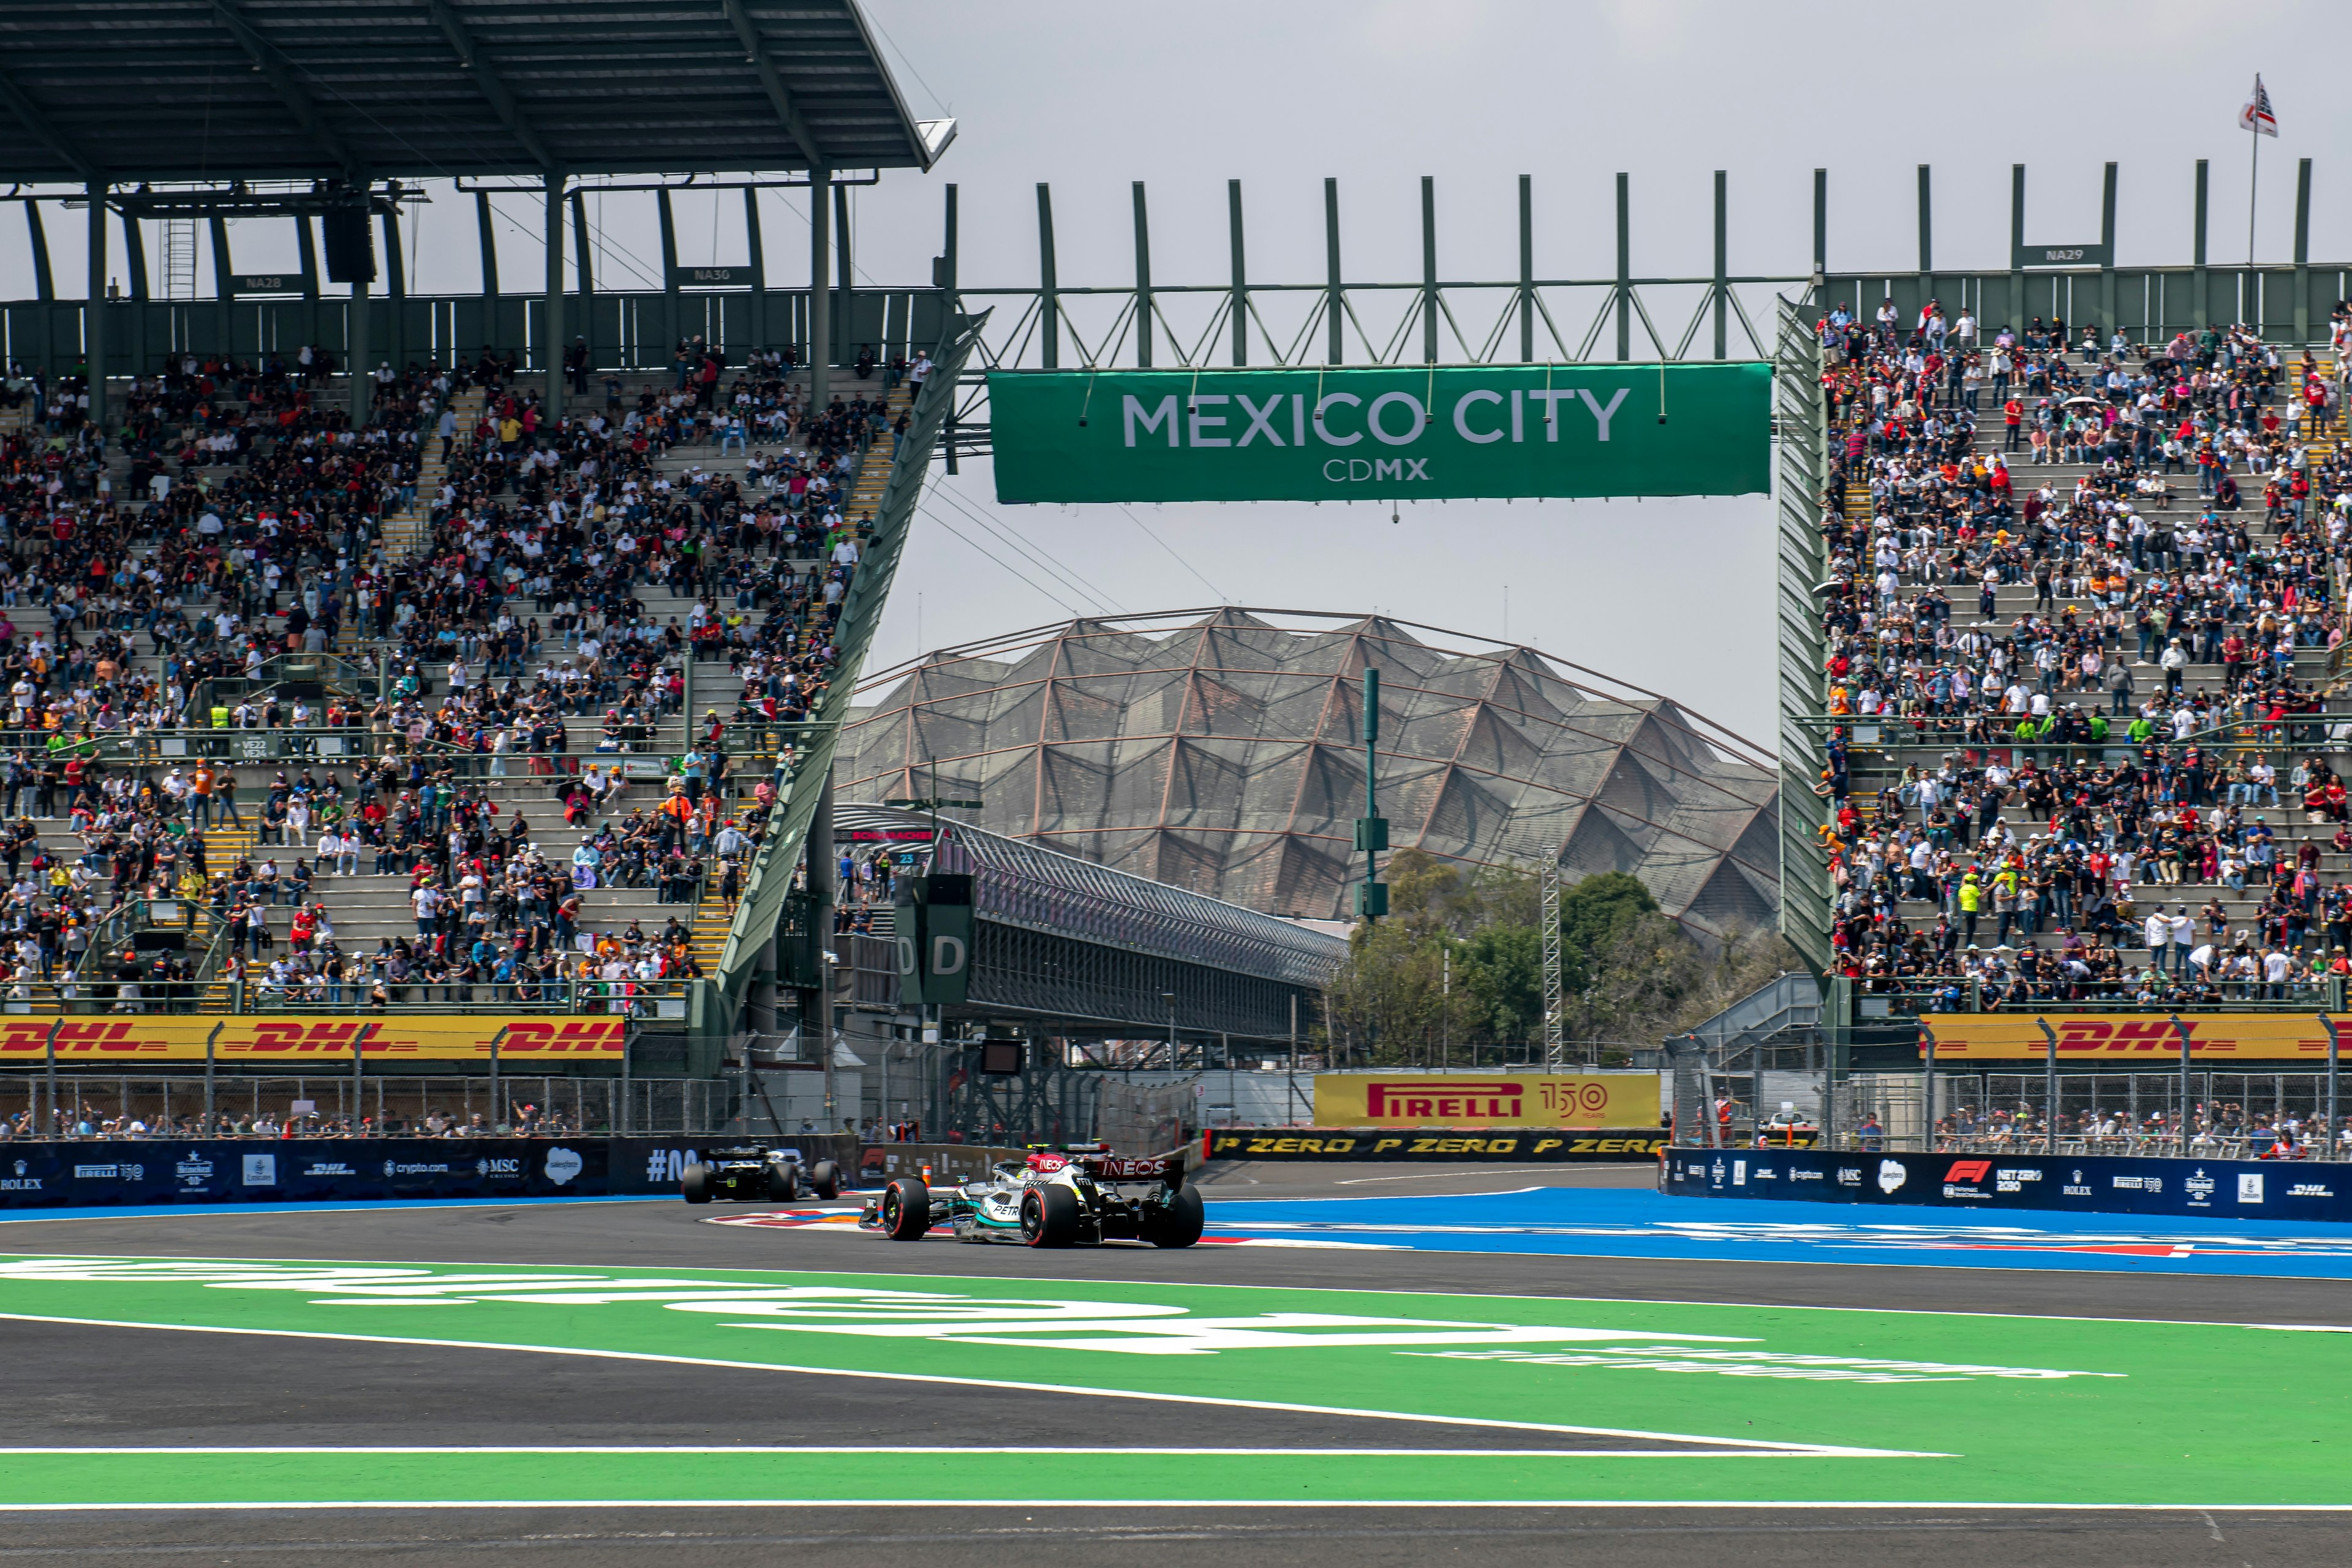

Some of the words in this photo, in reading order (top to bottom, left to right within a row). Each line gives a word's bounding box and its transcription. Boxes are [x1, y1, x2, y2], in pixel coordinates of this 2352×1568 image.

[2046, 250, 2084, 261] NA29
[694, 270, 730, 281] NA30
[246, 277, 282, 289] NA28
[1122, 391, 1427, 448] MEXICO
[1453, 388, 1632, 443] CITY
[1322, 457, 1431, 483] CDMX
[899, 854, 914, 864] 23
[896, 937, 914, 975] D
[932, 936, 966, 974] D
[1, 1022, 142, 1051] DHL
[250, 1022, 387, 1051] DHL
[2056, 1021, 2208, 1051] DHL
[1366, 1082, 1524, 1118] PIRELLI
[1539, 1082, 1608, 1118] 150
[1213, 1137, 1241, 1153] P
[1250, 1137, 1356, 1153] ZERO
[1373, 1139, 1402, 1153] P
[1411, 1138, 1518, 1153] ZERO
[1532, 1139, 1563, 1153] P
[311, 1163, 347, 1175] DHL
[396, 1163, 448, 1174] crypto.com
[490, 1159, 519, 1173] MSC
[1039, 1158, 1063, 1170] INEOS
[1102, 1160, 1165, 1177] INEOS
[74, 1164, 118, 1178] PIRELLI
[1996, 1169, 2016, 1180] NET
[2016, 1169, 2043, 1181] ZERO
[1, 1179, 42, 1190] ROLEX
[1996, 1180, 2021, 1191] 2030
[2113, 1176, 2143, 1188] PIRELLI
[2063, 1186, 2092, 1195] ROLEX
[2293, 1184, 2326, 1196] DHL
[1392, 1351, 1977, 1383] HIDRATATE
